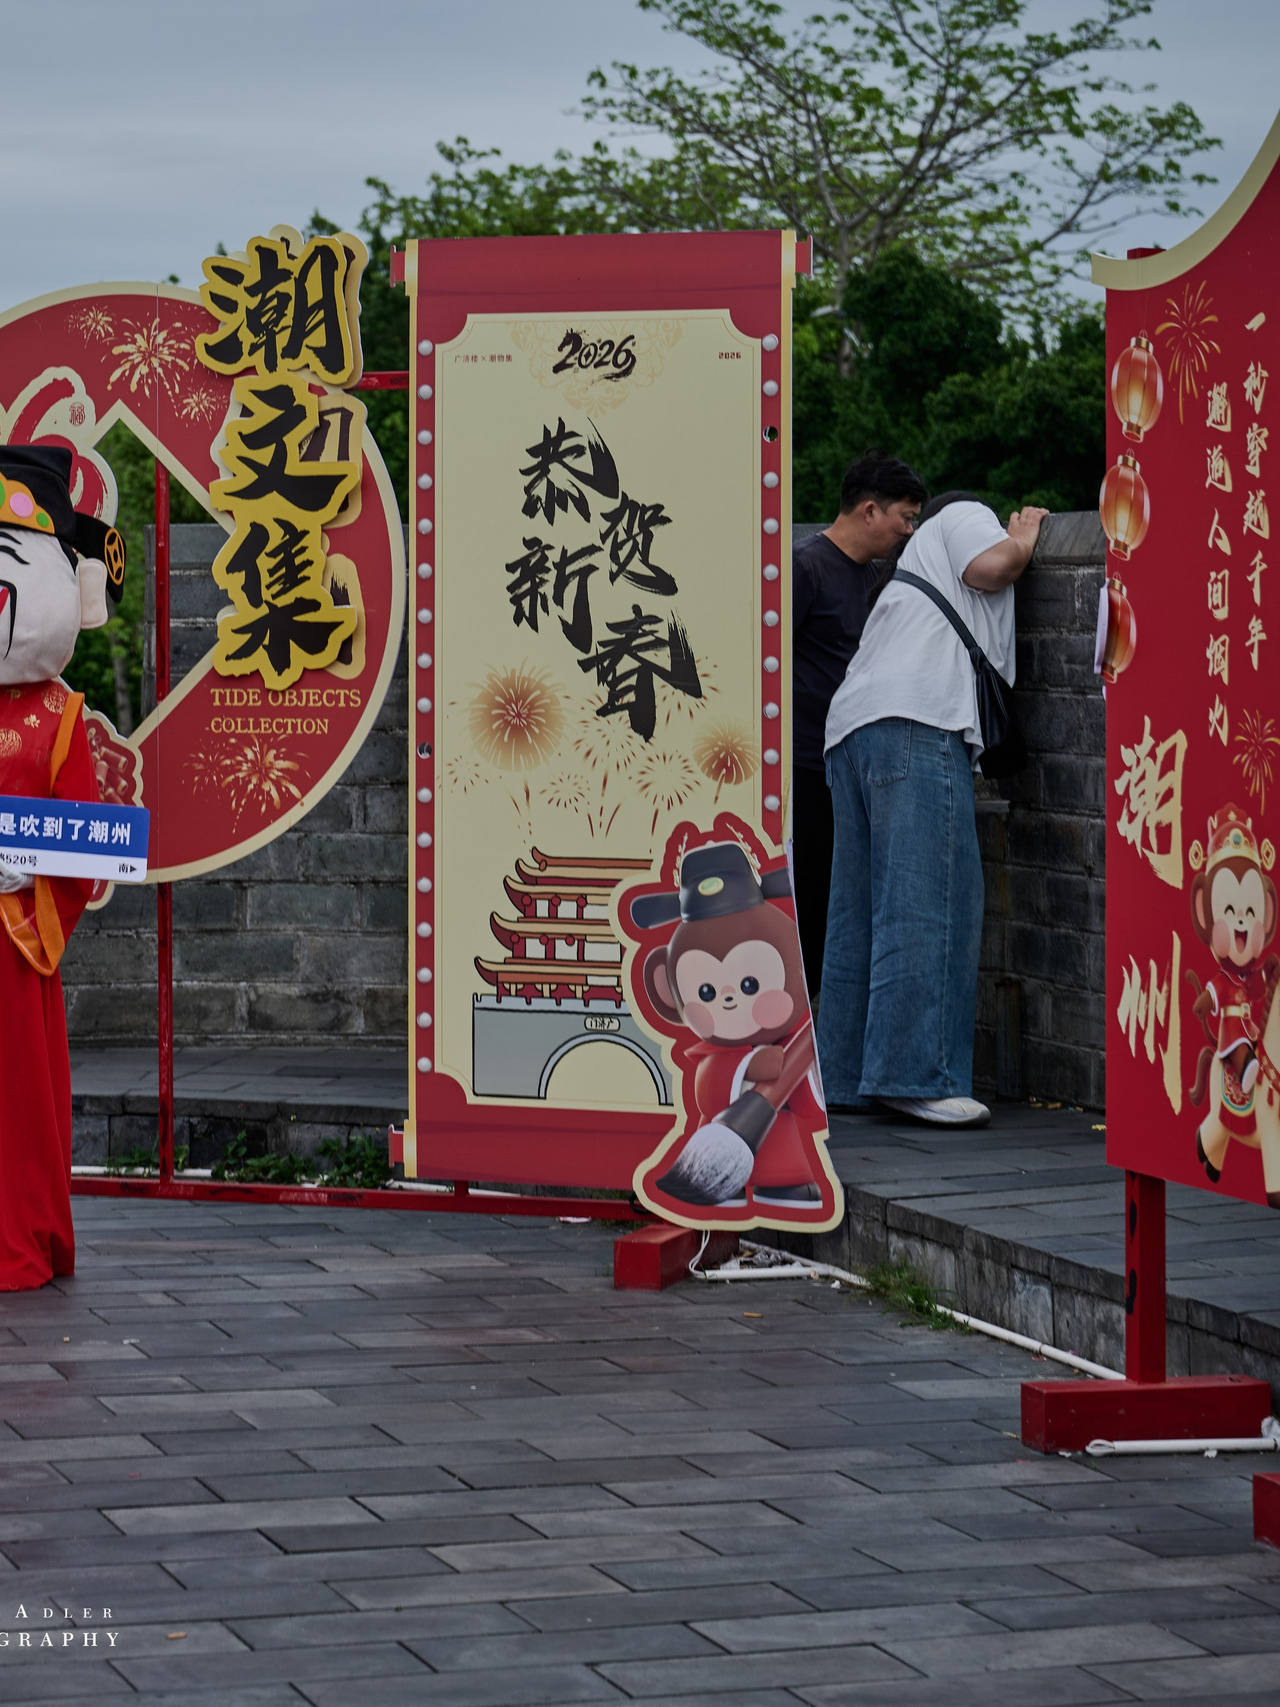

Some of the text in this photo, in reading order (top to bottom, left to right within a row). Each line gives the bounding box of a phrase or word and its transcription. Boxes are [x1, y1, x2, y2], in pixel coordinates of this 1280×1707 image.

[552, 328, 637, 382] 2026
[204, 244, 349, 676] 潮文集
[1242, 312, 1270, 671] 一秒穿越千年
[210, 688, 361, 707] TIDE OBJECTS
[210, 718, 329, 734] COLLECTION
[1114, 715, 1188, 1116] 潮州
